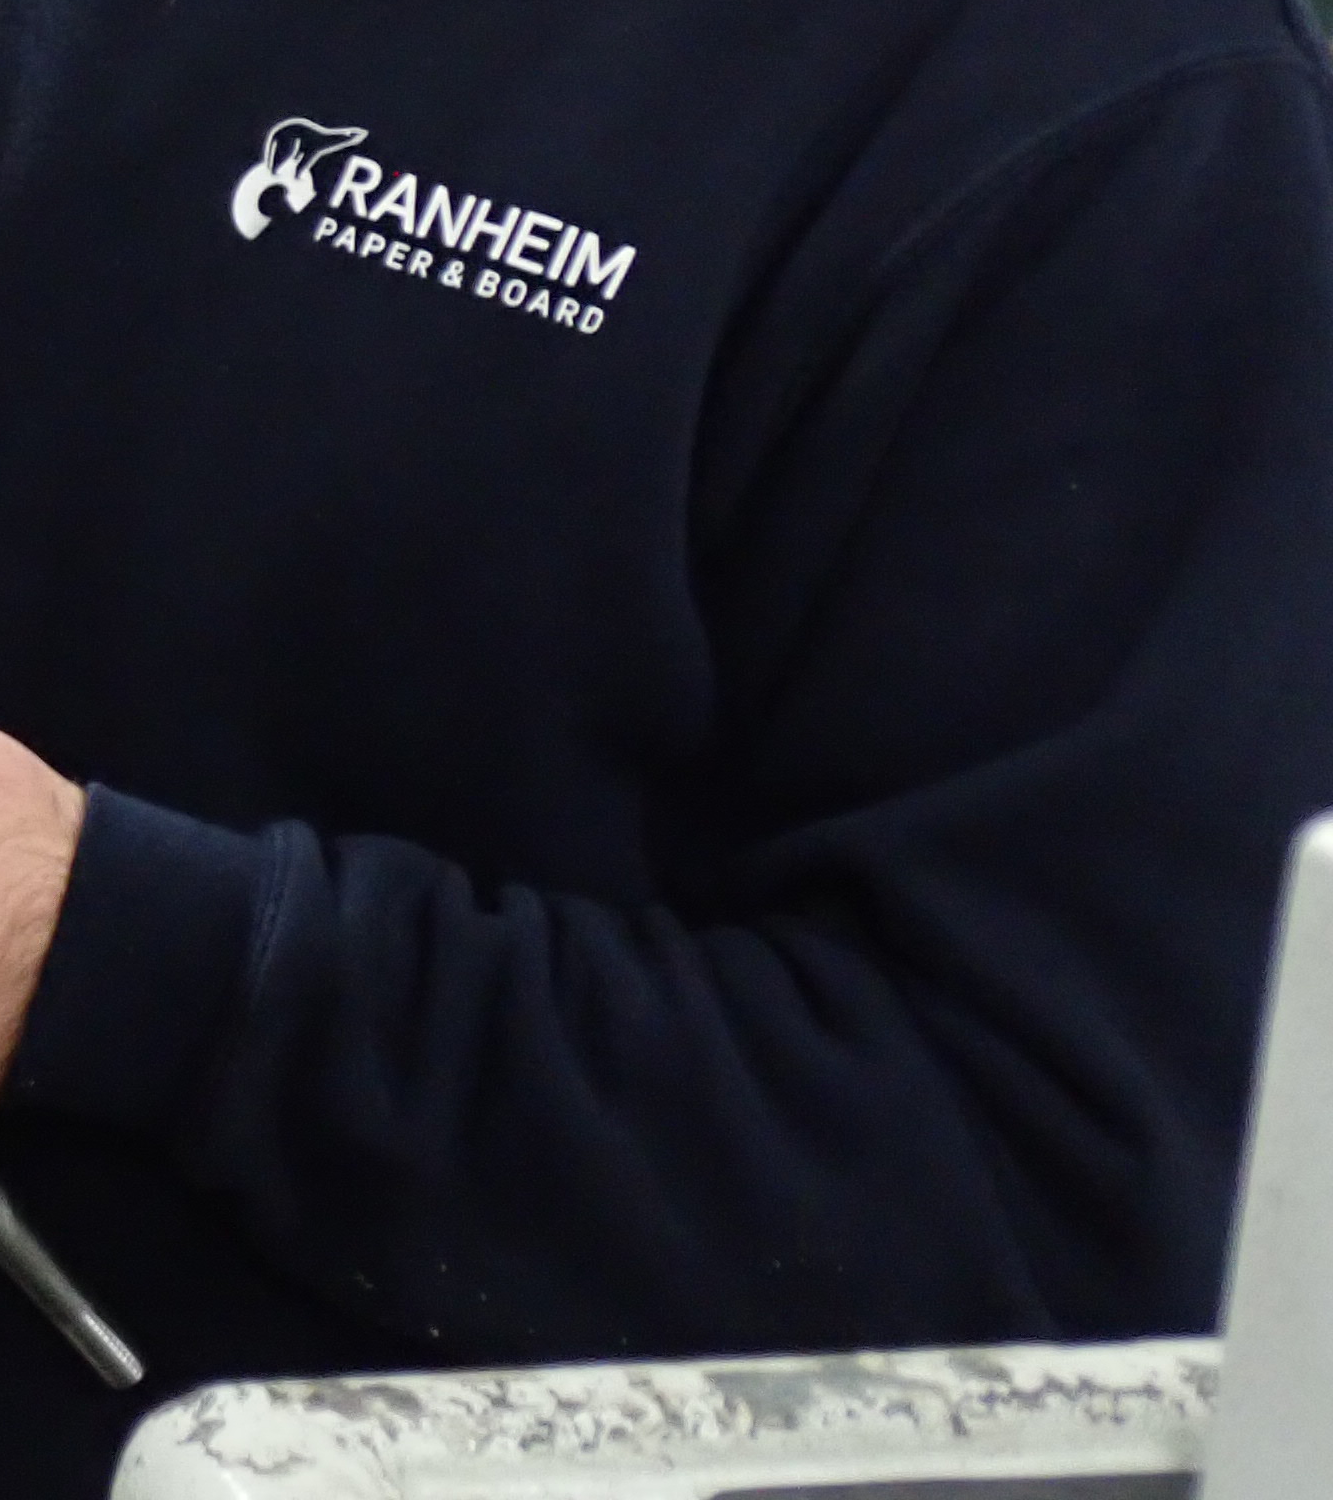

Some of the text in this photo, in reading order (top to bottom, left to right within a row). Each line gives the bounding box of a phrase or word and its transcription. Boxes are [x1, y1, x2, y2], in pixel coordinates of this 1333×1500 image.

[312, 216, 605, 335] PAPER & BOARD
[329, 155, 636, 300] RANHEIM
